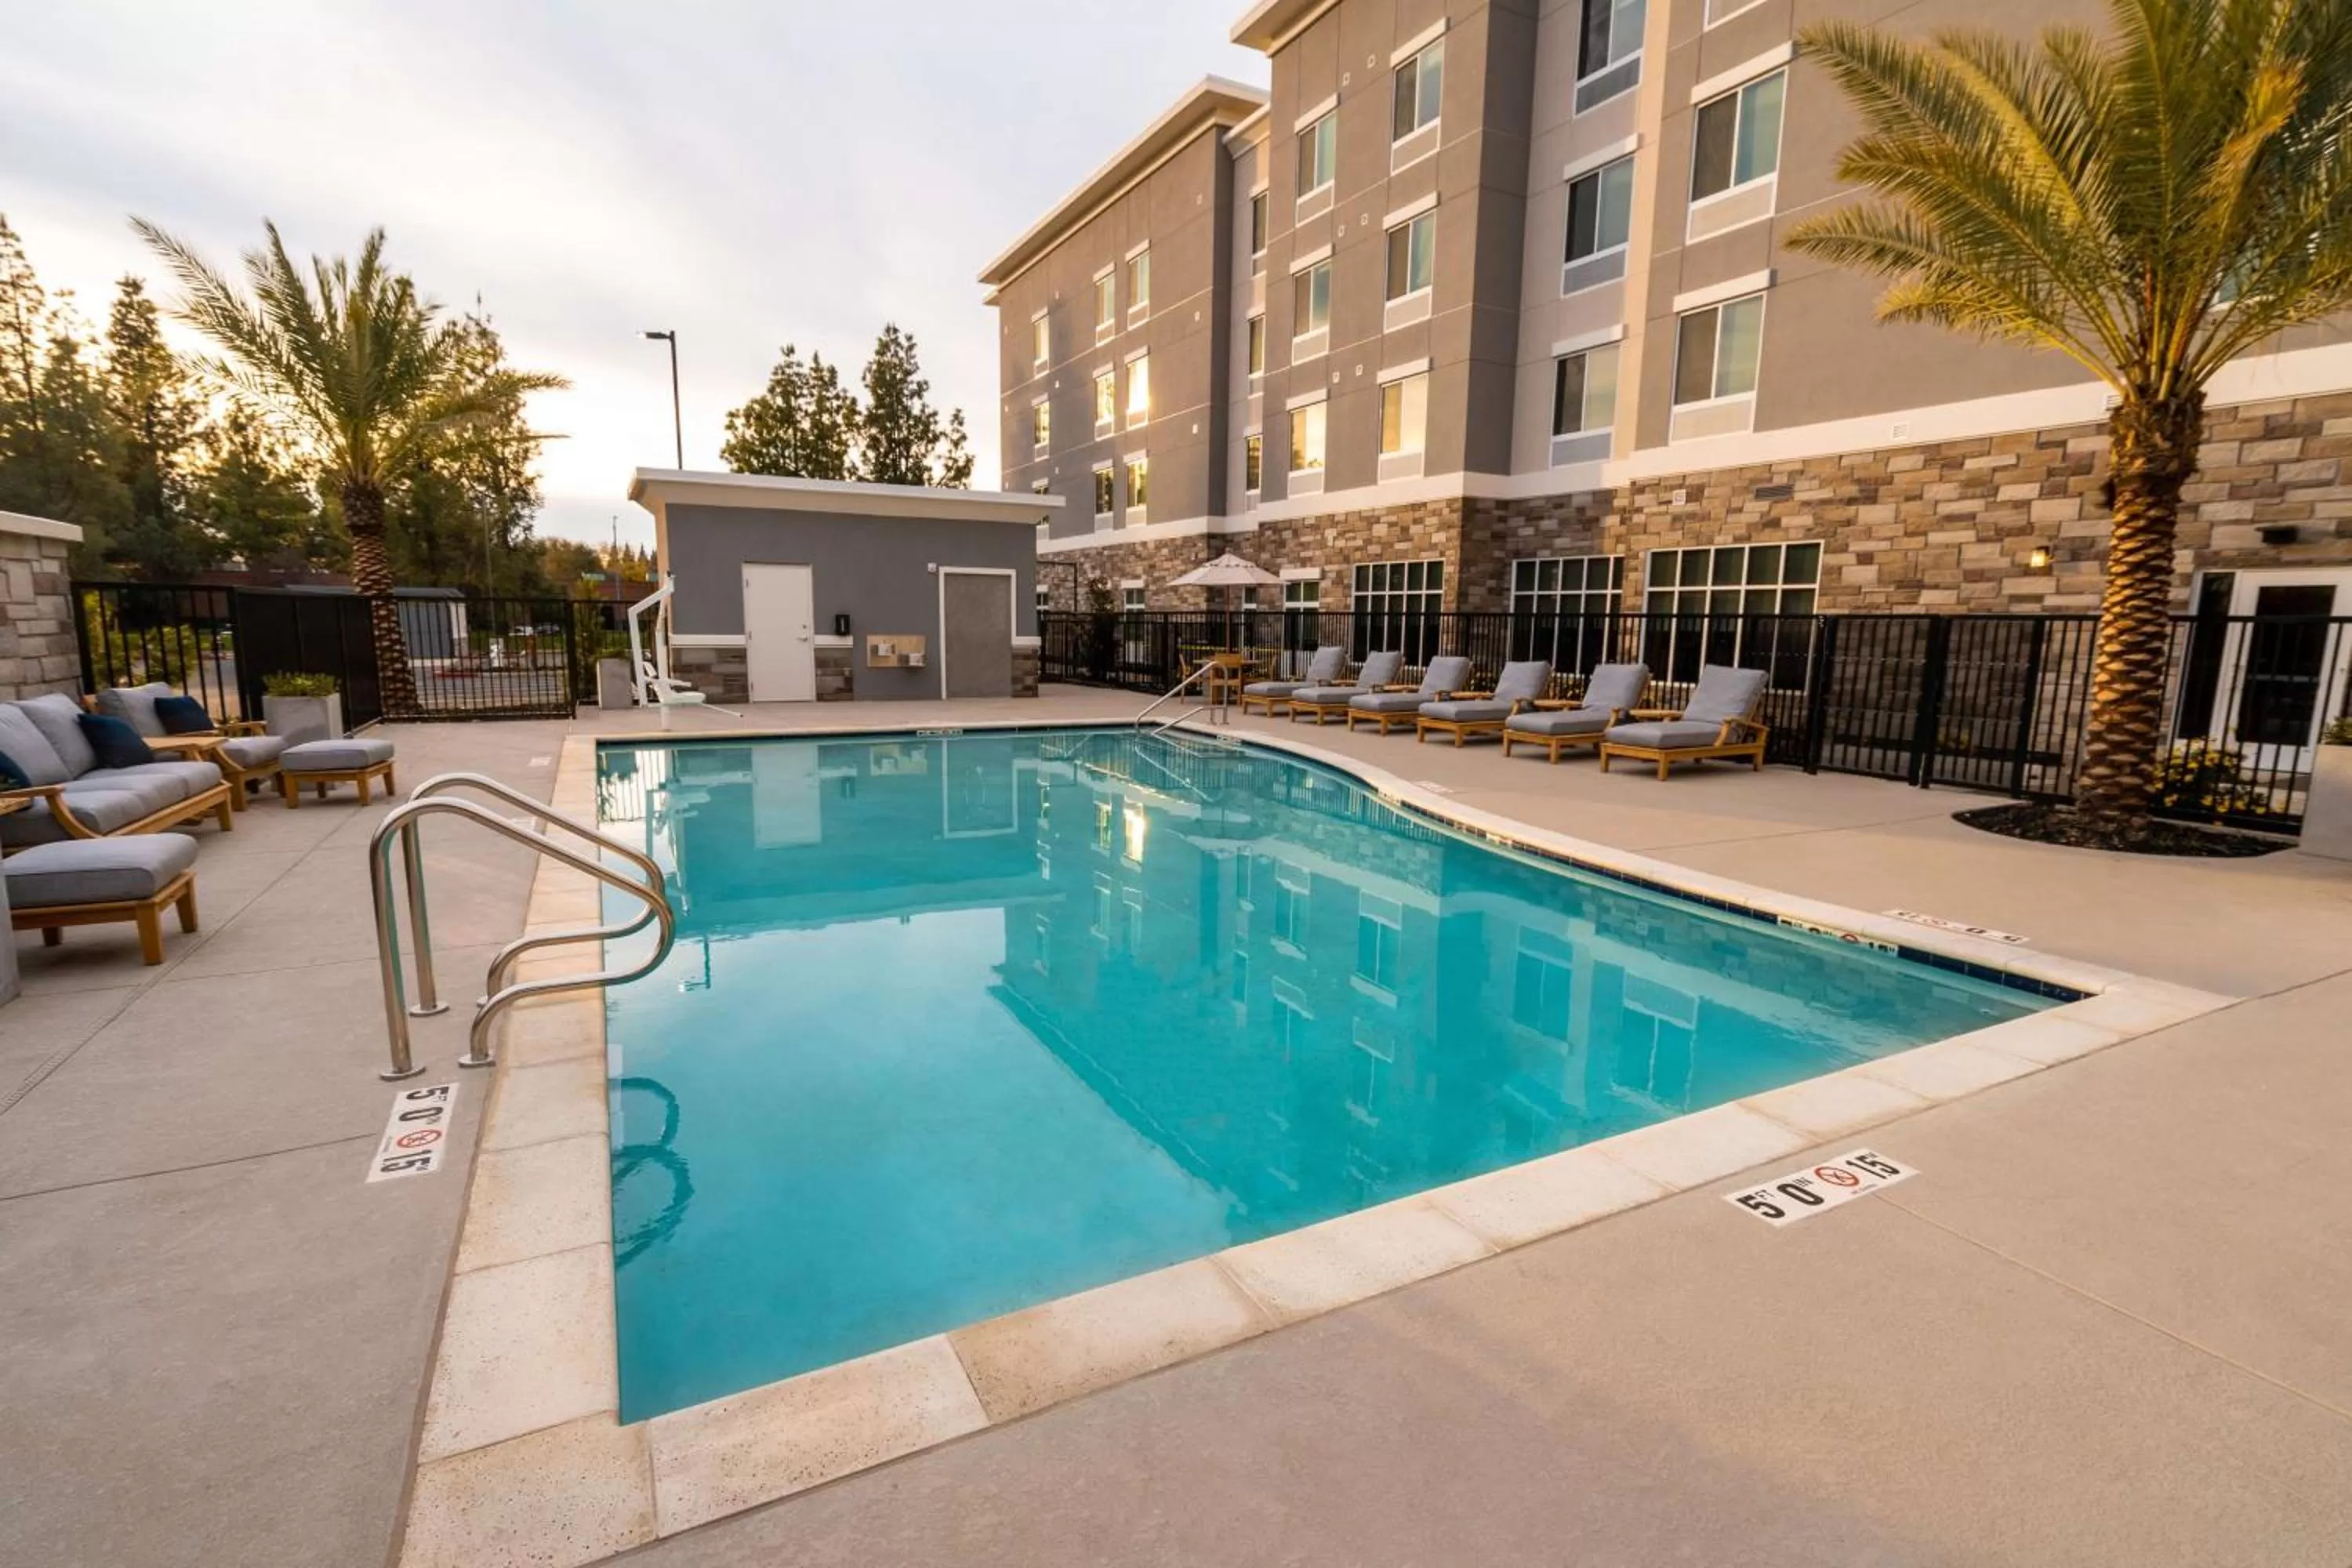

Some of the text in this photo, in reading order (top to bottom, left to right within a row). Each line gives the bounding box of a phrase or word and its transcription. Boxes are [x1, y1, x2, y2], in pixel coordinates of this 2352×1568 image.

[406, 1086, 449, 1100] 5
[399, 1106, 444, 1122] 0
[1736, 1193, 1785, 1219] 5
[1777, 1182, 1824, 1207] 0
